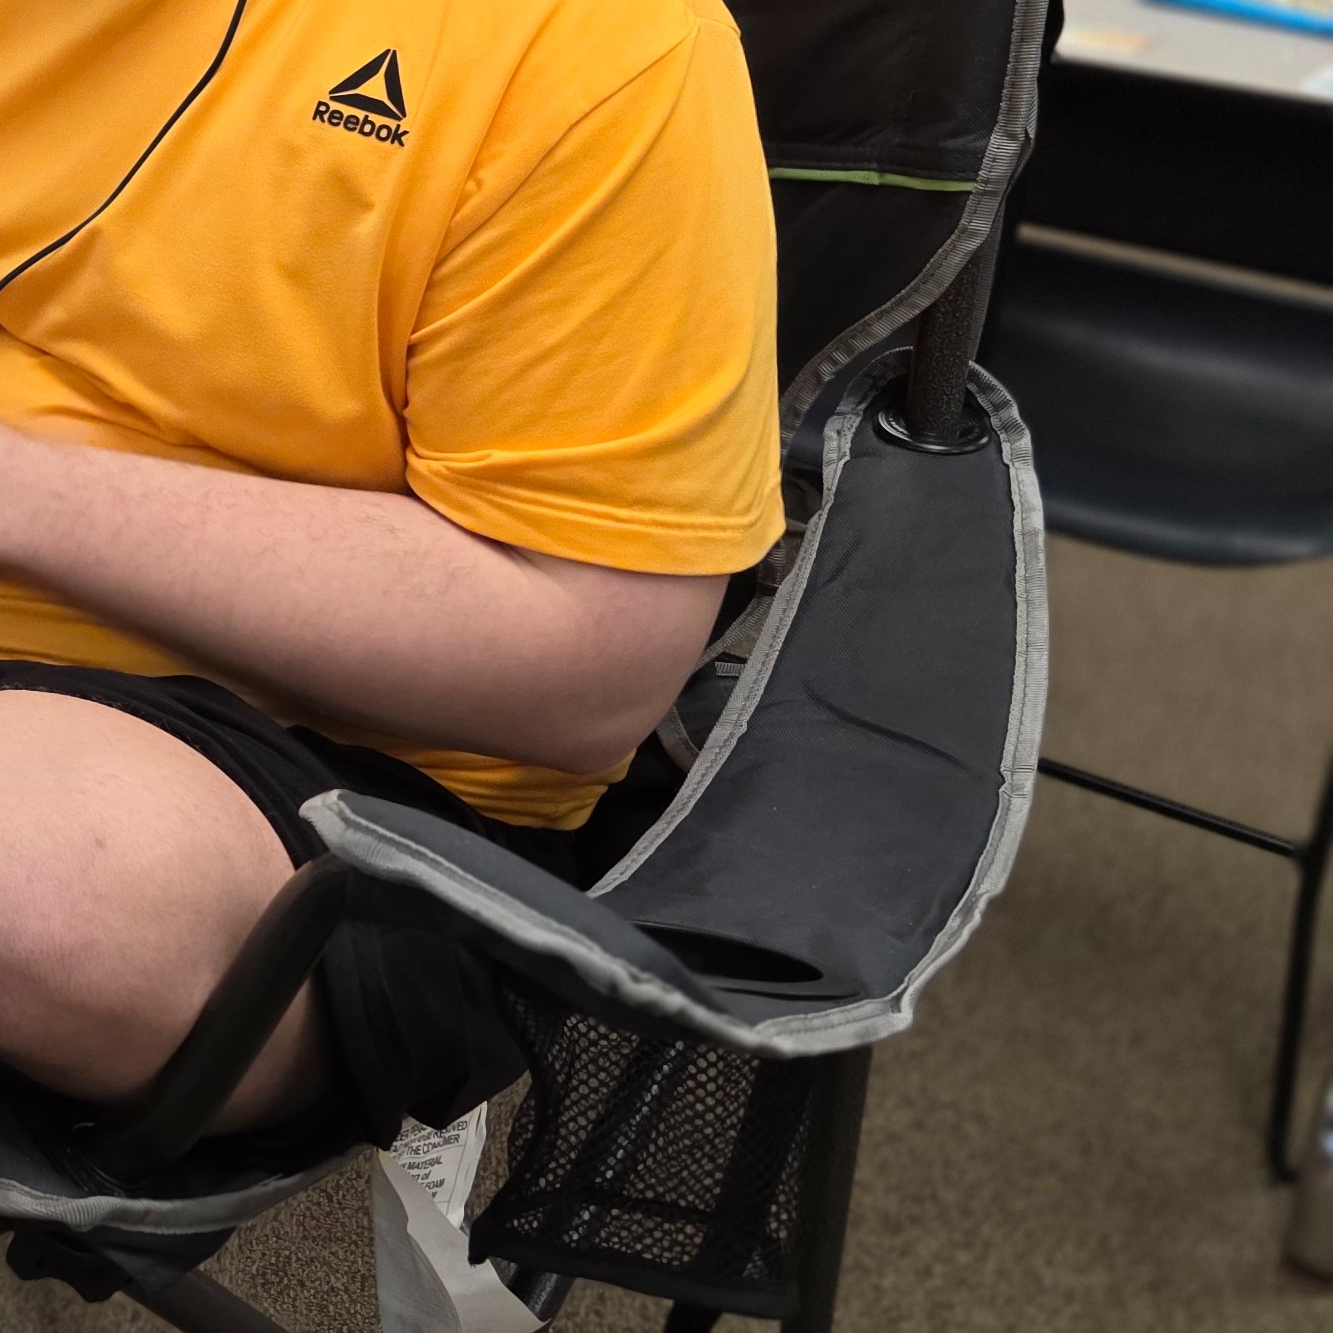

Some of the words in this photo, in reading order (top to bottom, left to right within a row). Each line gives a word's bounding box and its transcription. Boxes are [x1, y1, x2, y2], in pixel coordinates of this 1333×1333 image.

[311, 100, 410, 148] Reebok
[406, 1144, 422, 1156] THE
[406, 1155, 443, 1170] MATERIAL
[424, 1178, 446, 1190] FOAM
